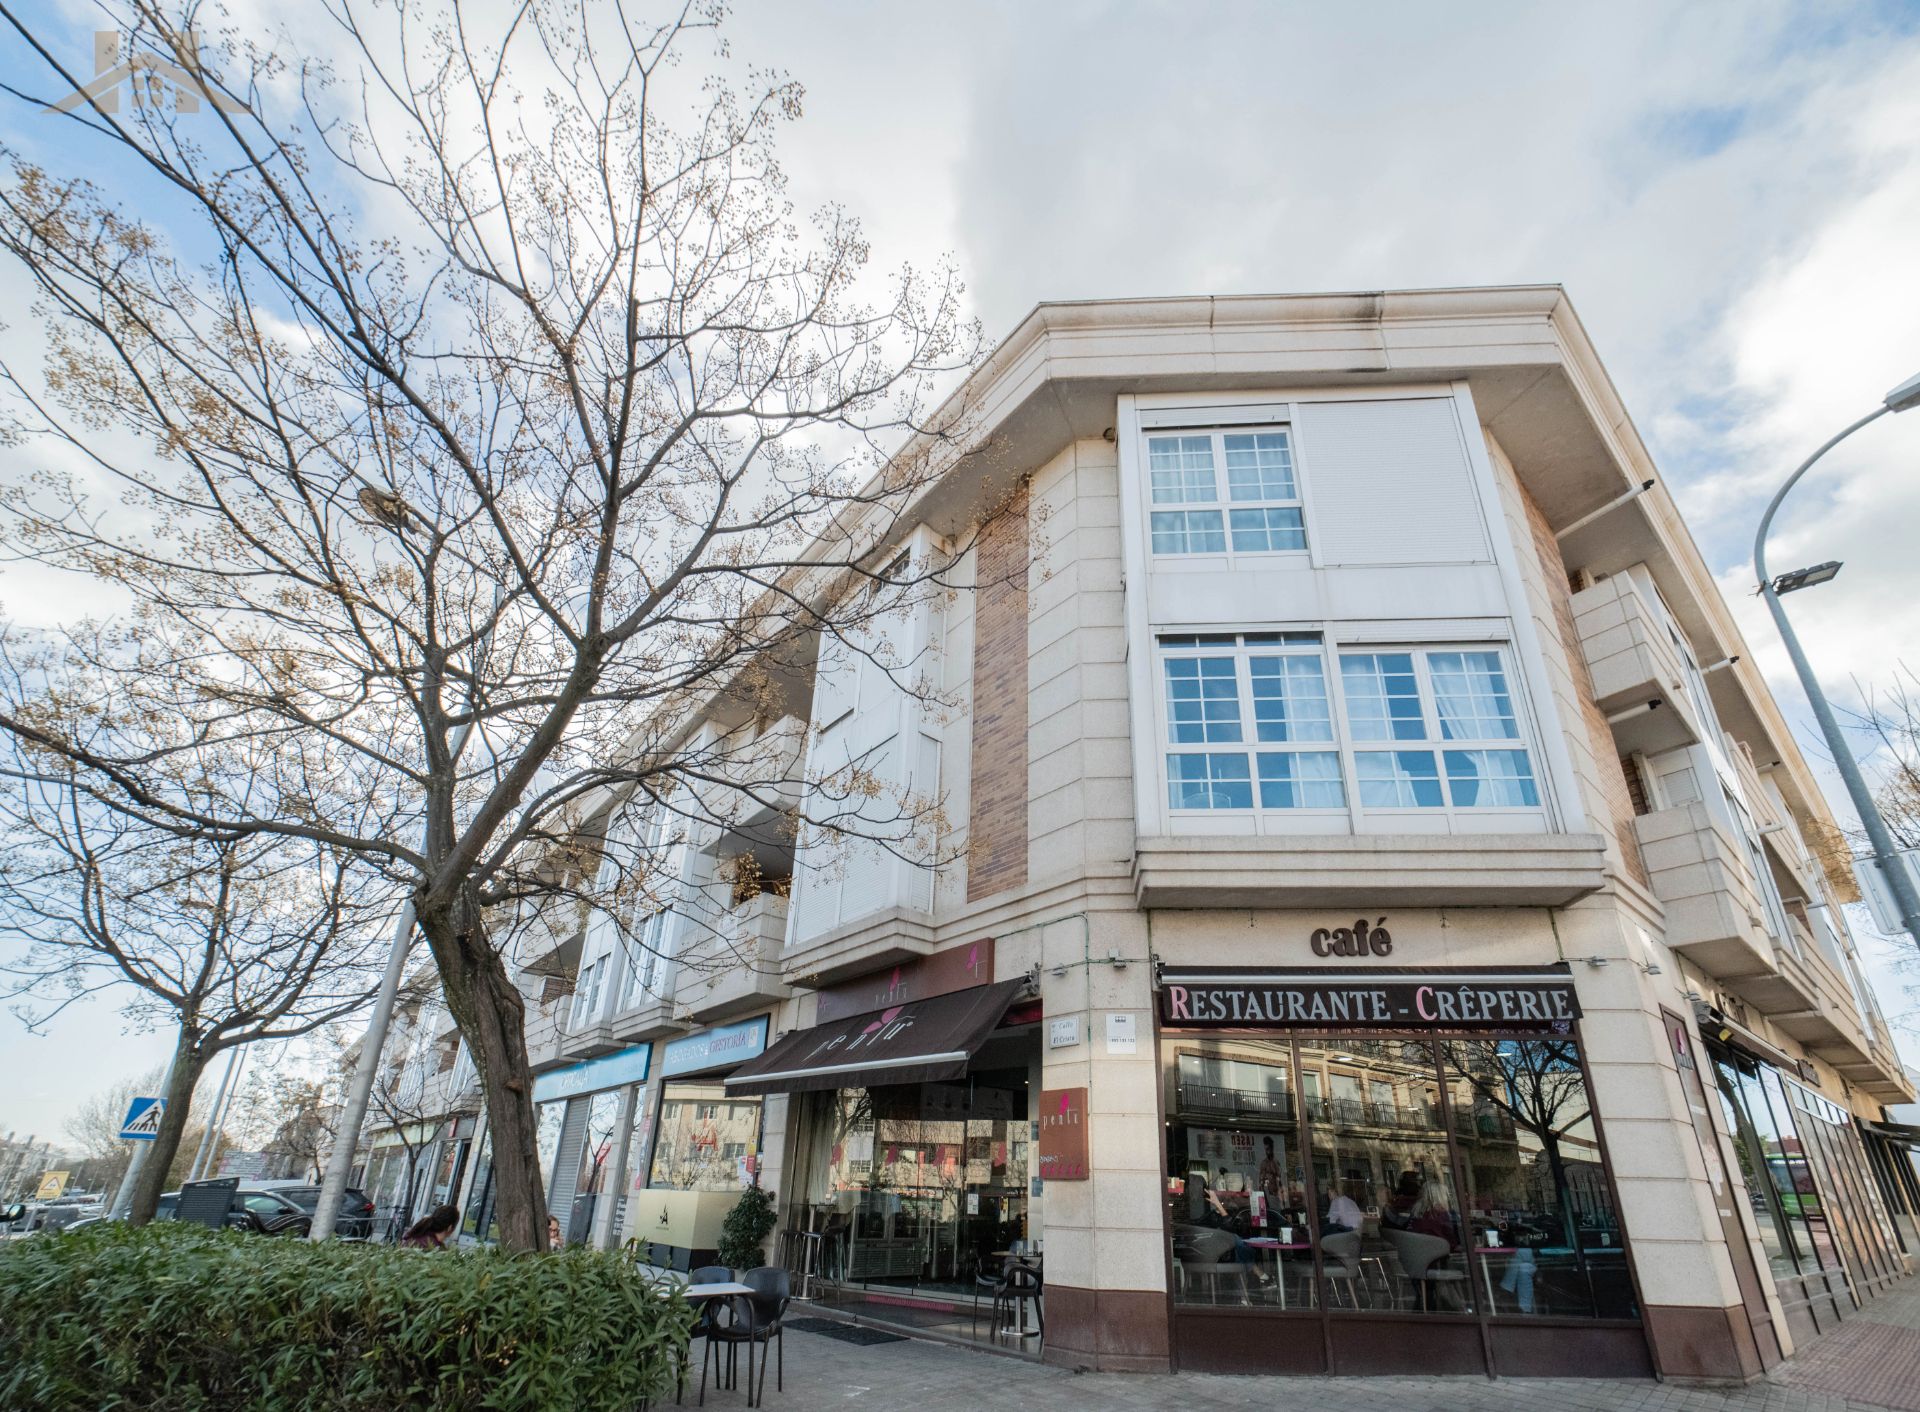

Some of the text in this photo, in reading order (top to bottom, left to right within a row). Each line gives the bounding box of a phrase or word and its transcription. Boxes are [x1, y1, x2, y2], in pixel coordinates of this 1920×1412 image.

[1310, 916, 1393, 957] café
[1169, 986, 1391, 1020] RESTAURANTE
[1416, 985, 1574, 1021] CRÊPERIE
